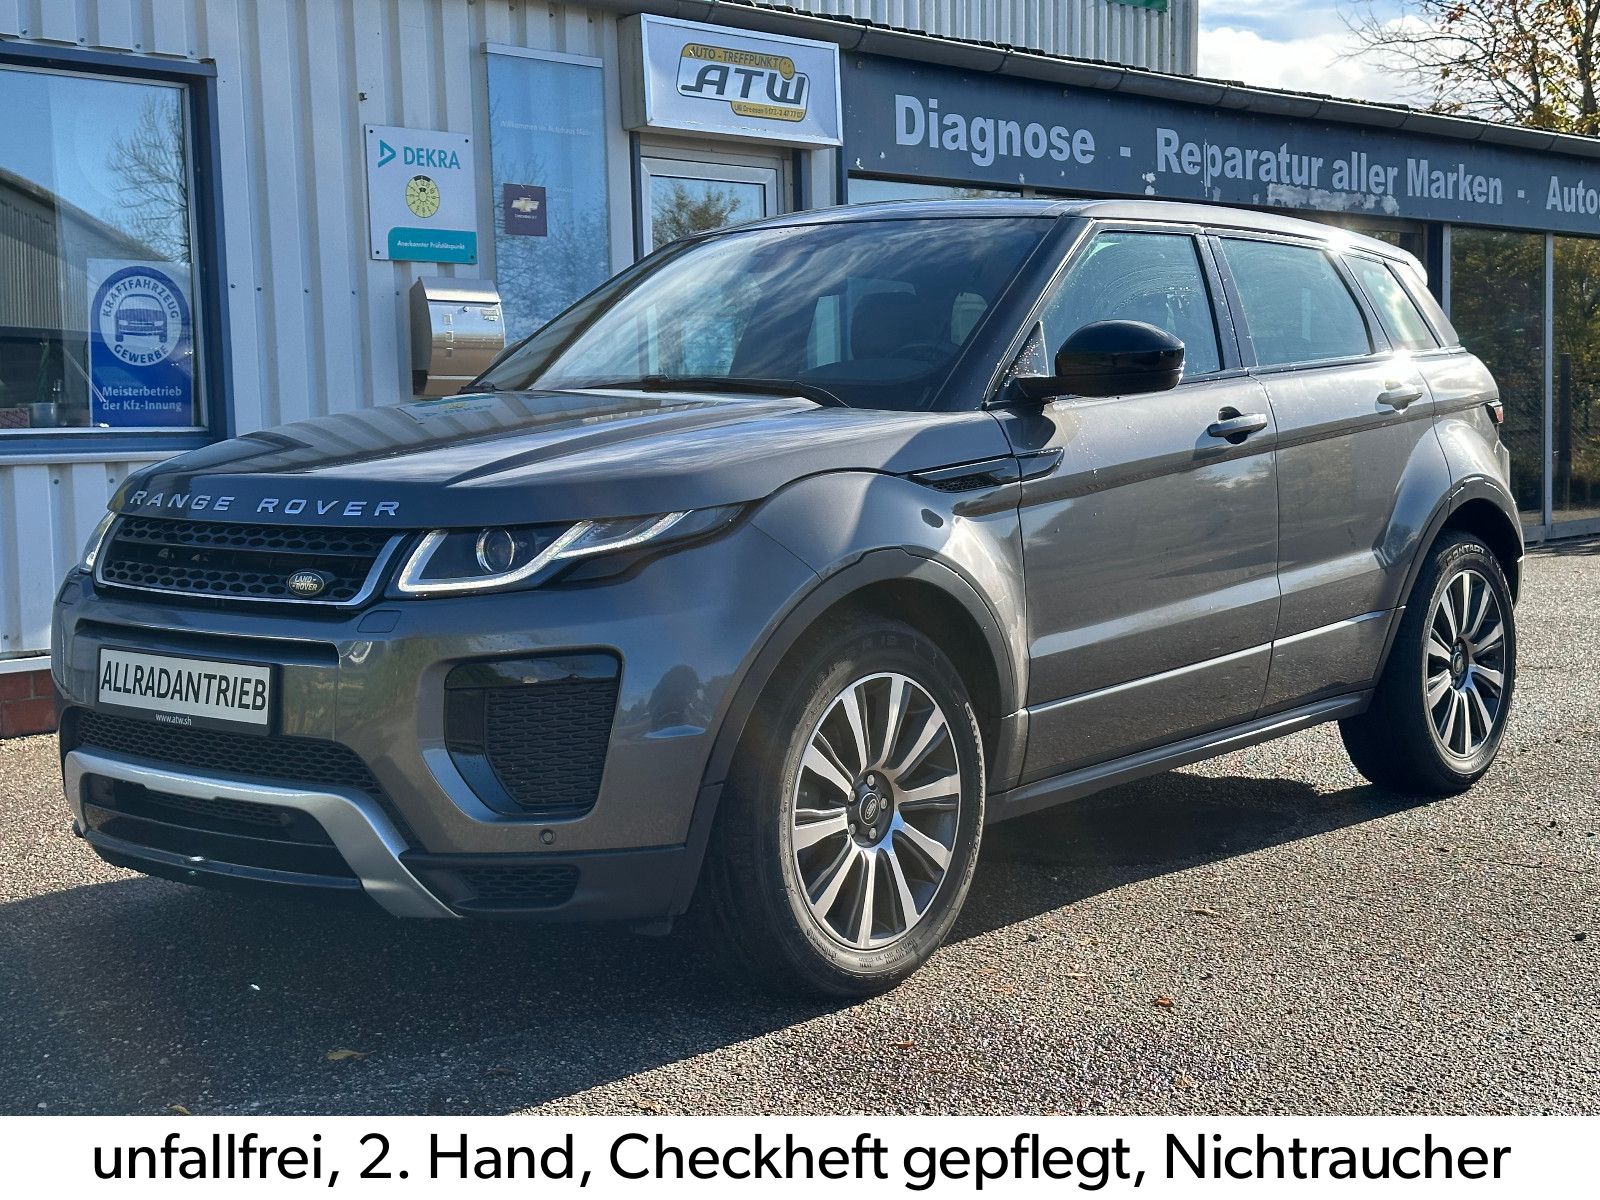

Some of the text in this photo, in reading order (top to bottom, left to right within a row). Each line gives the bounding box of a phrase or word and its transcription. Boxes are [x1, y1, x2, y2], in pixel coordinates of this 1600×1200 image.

[688, 47, 716, 60] AUTO
[722, 50, 779, 69] TREFFPUNKT
[681, 64, 806, 105] ATW
[403, 146, 461, 170] DEKRA
[895, 94, 1096, 167] Diagnose
[1156, 127, 1324, 188] Reparatur
[1331, 151, 1399, 195] aller
[1406, 158, 1503, 205] Marken
[1545, 175, 1600, 217] Auto
[102, 278, 180, 319] KRAFTFAHRZEUG
[113, 344, 170, 364] GEWERBE
[102, 385, 182, 397] Meisterbetrieb
[102, 400, 182, 412] der Kfz-Innung
[130, 490, 400, 517] RANGE ROVER
[100, 659, 267, 712] ALLRADANTRIEB
[155, 712, 192, 726] www.atw.sh
